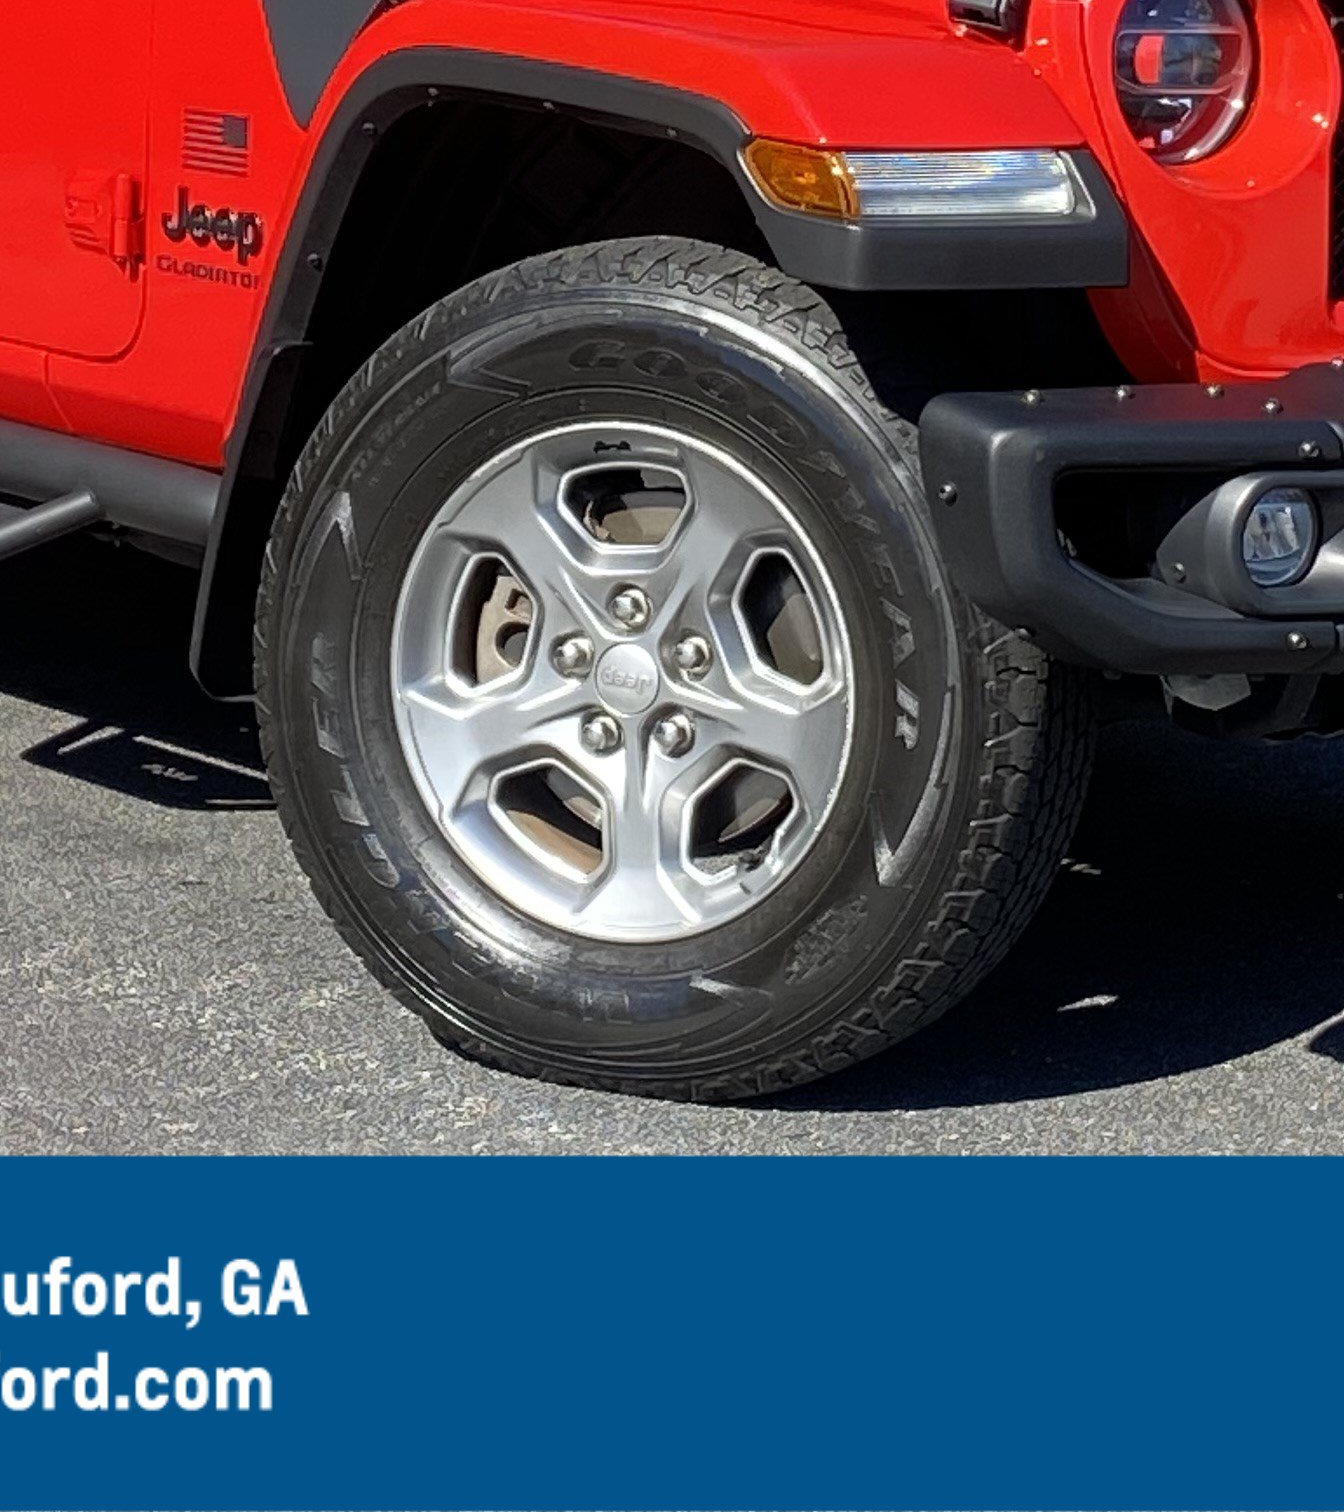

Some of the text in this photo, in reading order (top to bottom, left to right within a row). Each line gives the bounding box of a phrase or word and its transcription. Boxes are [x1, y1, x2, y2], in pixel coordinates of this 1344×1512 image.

[161, 185, 264, 266] Jeep
[568, 339, 921, 751] GOODYEAR
[600, 666, 655, 695] Jeep
